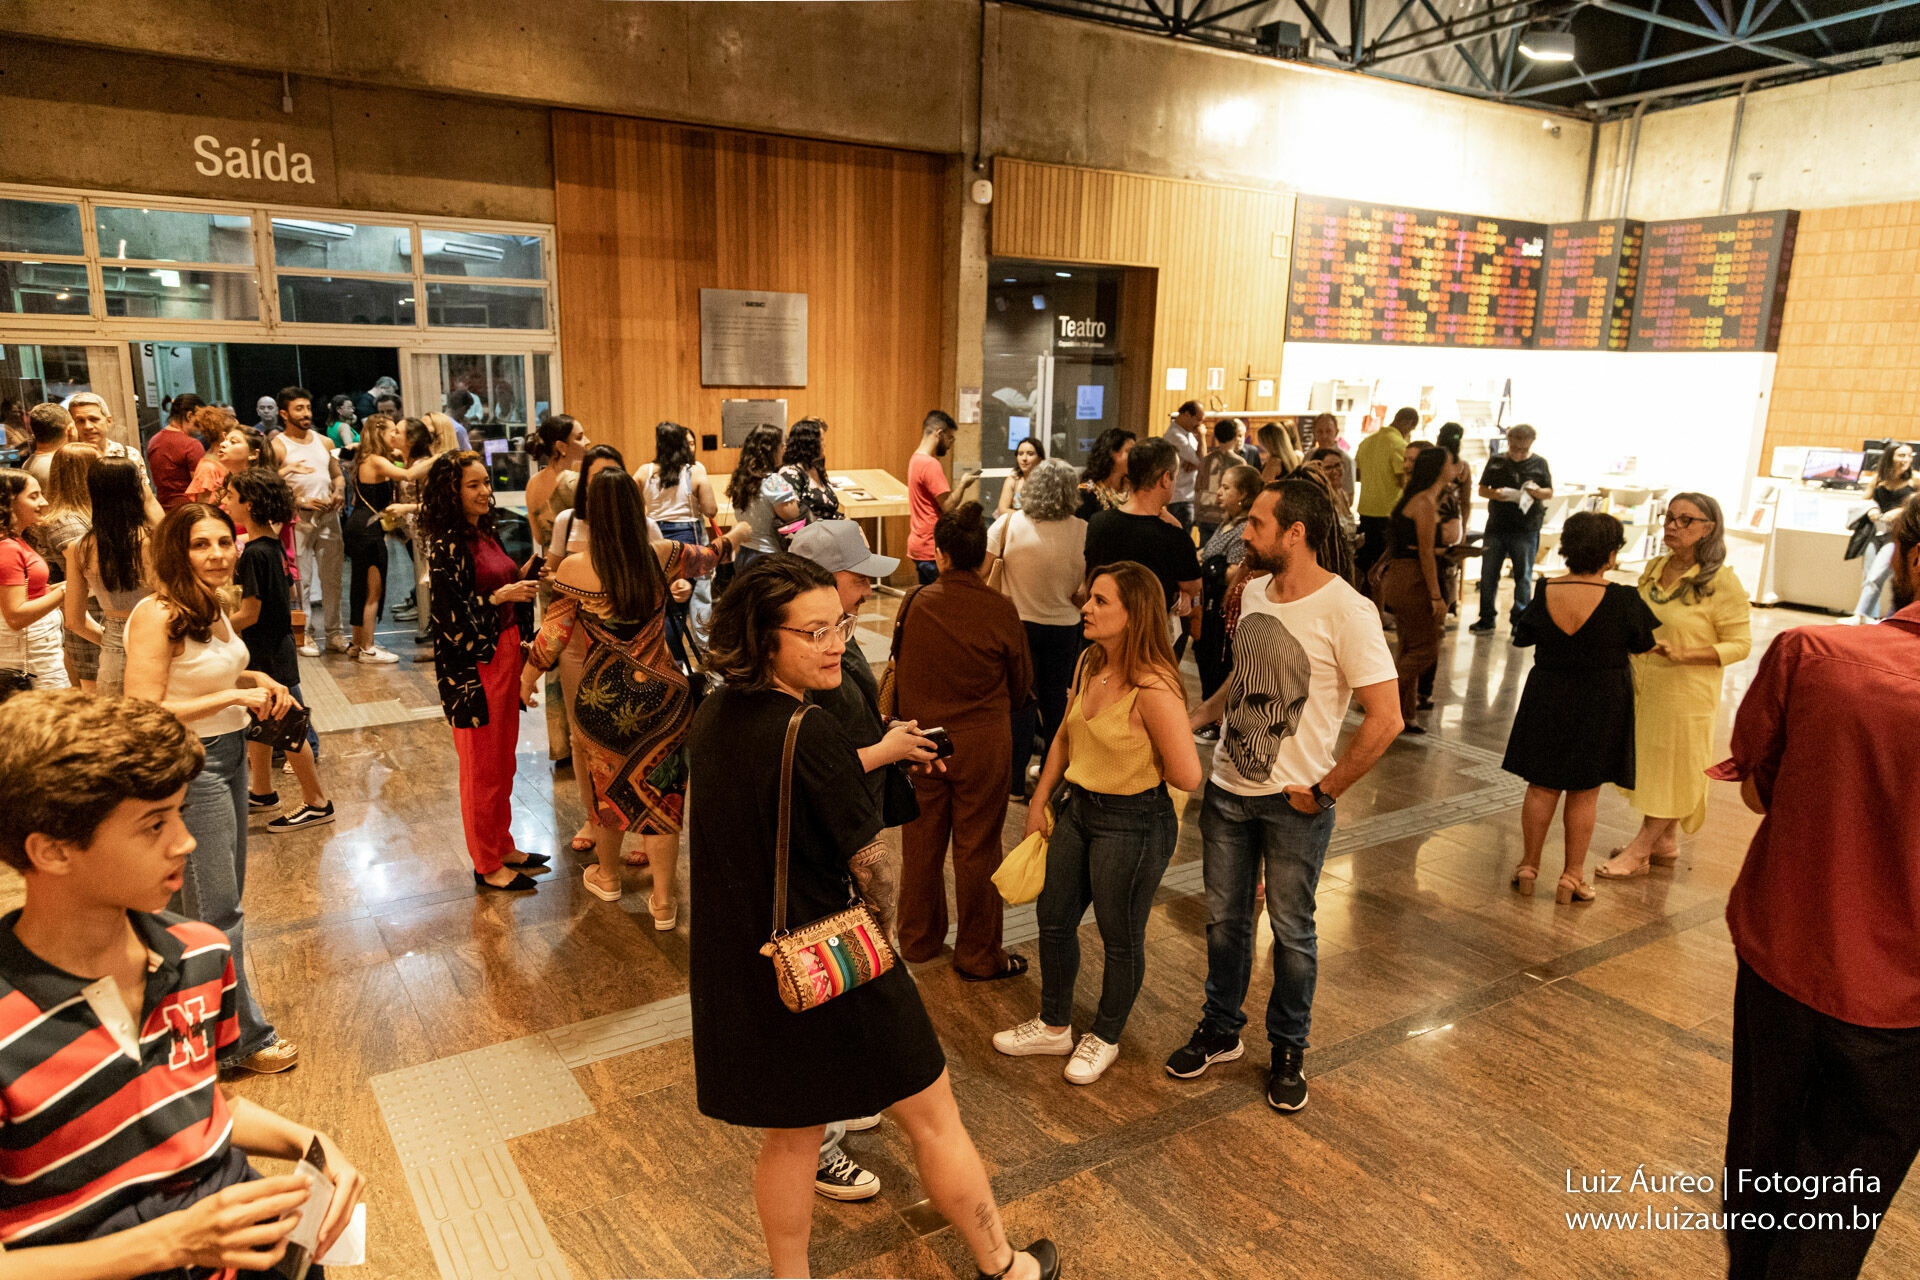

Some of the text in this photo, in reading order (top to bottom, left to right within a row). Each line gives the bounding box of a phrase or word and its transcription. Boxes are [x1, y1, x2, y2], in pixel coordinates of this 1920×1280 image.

[193, 134, 316, 184] Saída
[1058, 315, 1106, 338] Teatro
[162, 995, 208, 1071] N
